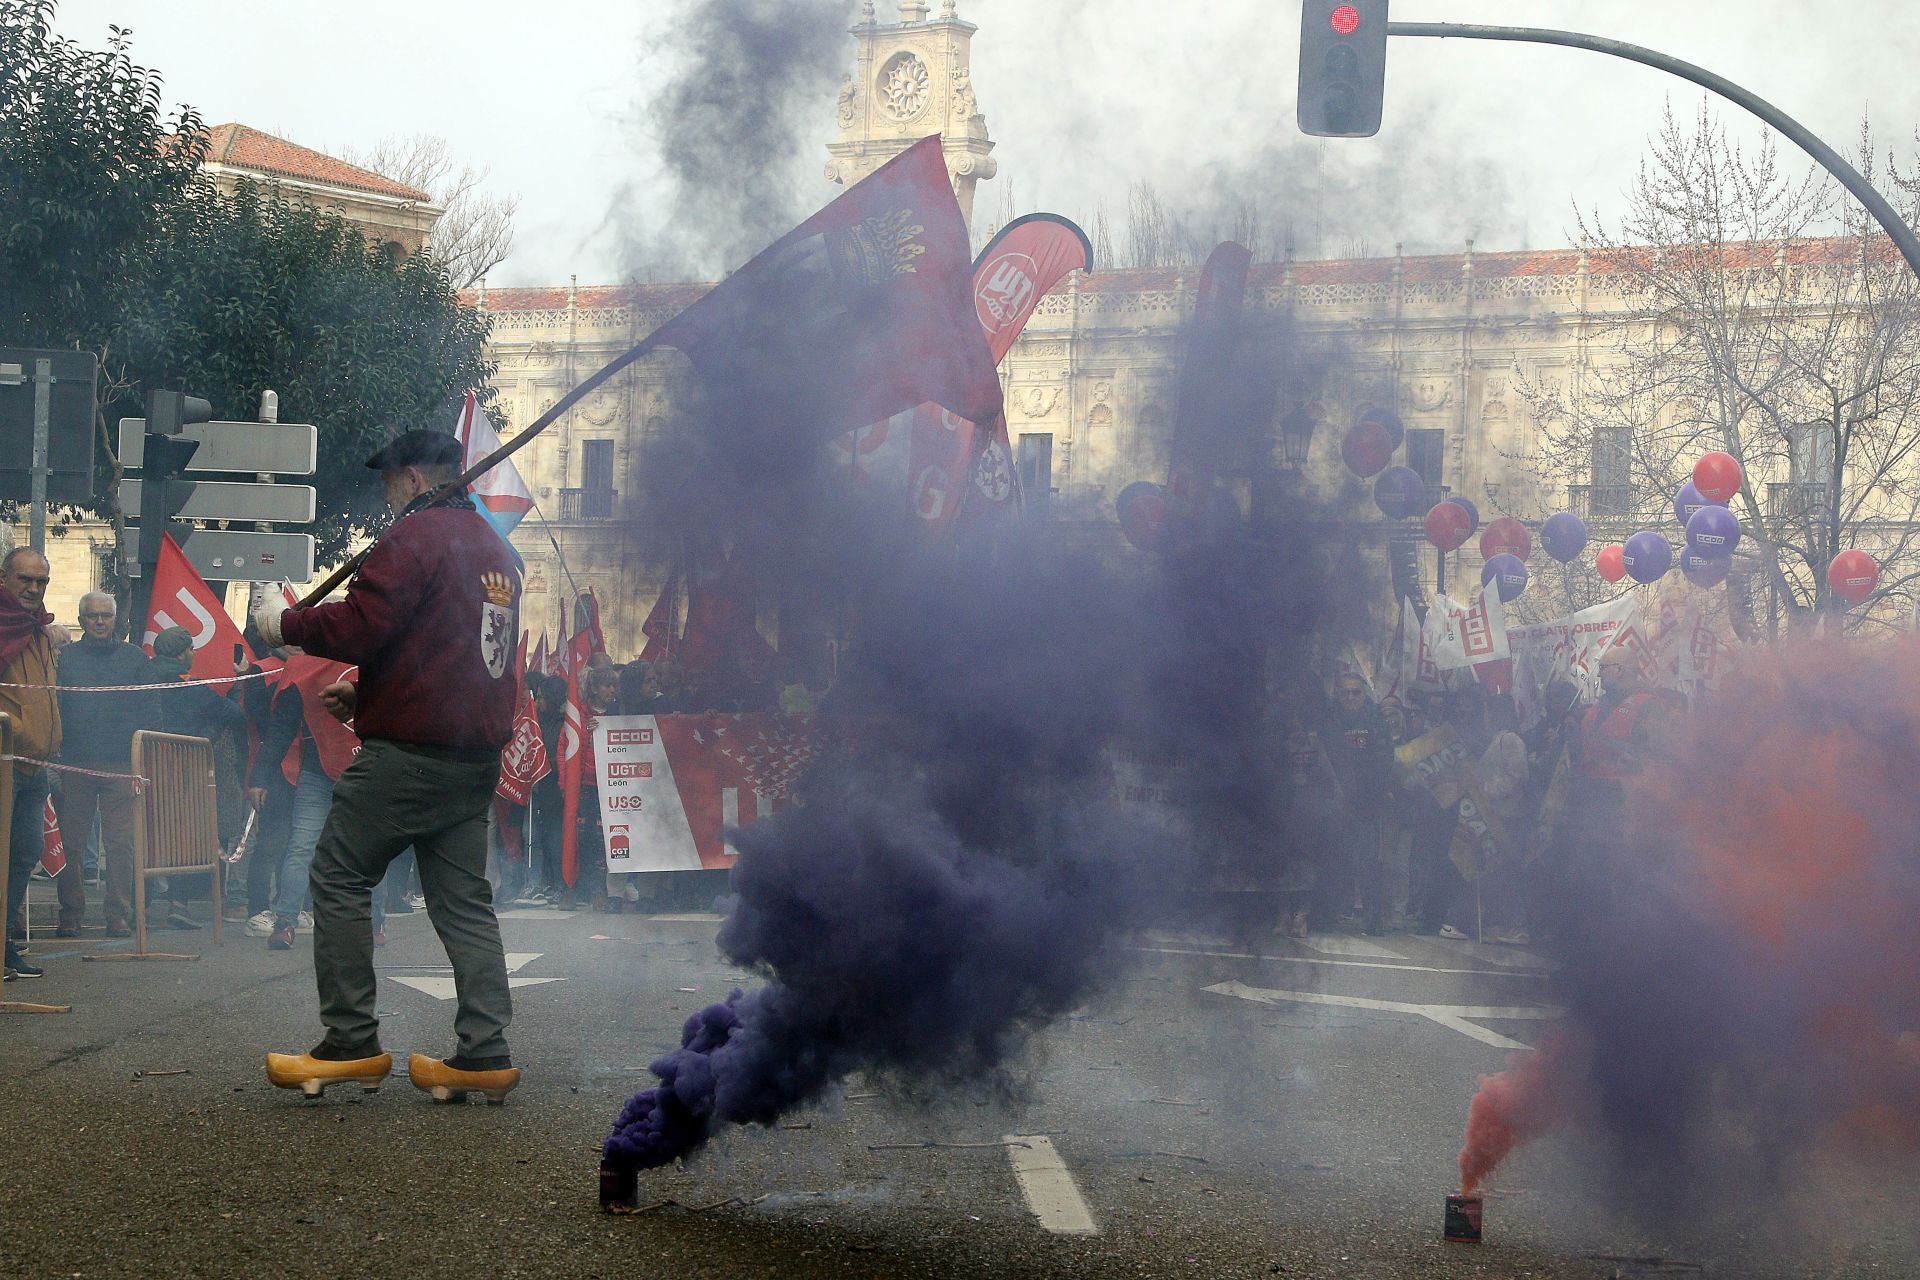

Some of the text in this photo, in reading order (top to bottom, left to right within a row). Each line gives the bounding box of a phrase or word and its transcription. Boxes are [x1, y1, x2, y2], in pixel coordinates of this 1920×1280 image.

[610, 731, 651, 742] CCOO
[610, 765, 638, 776] UGT
[608, 779, 628, 787] León
[608, 795, 642, 809] USO
[611, 847, 629, 855] CGT
